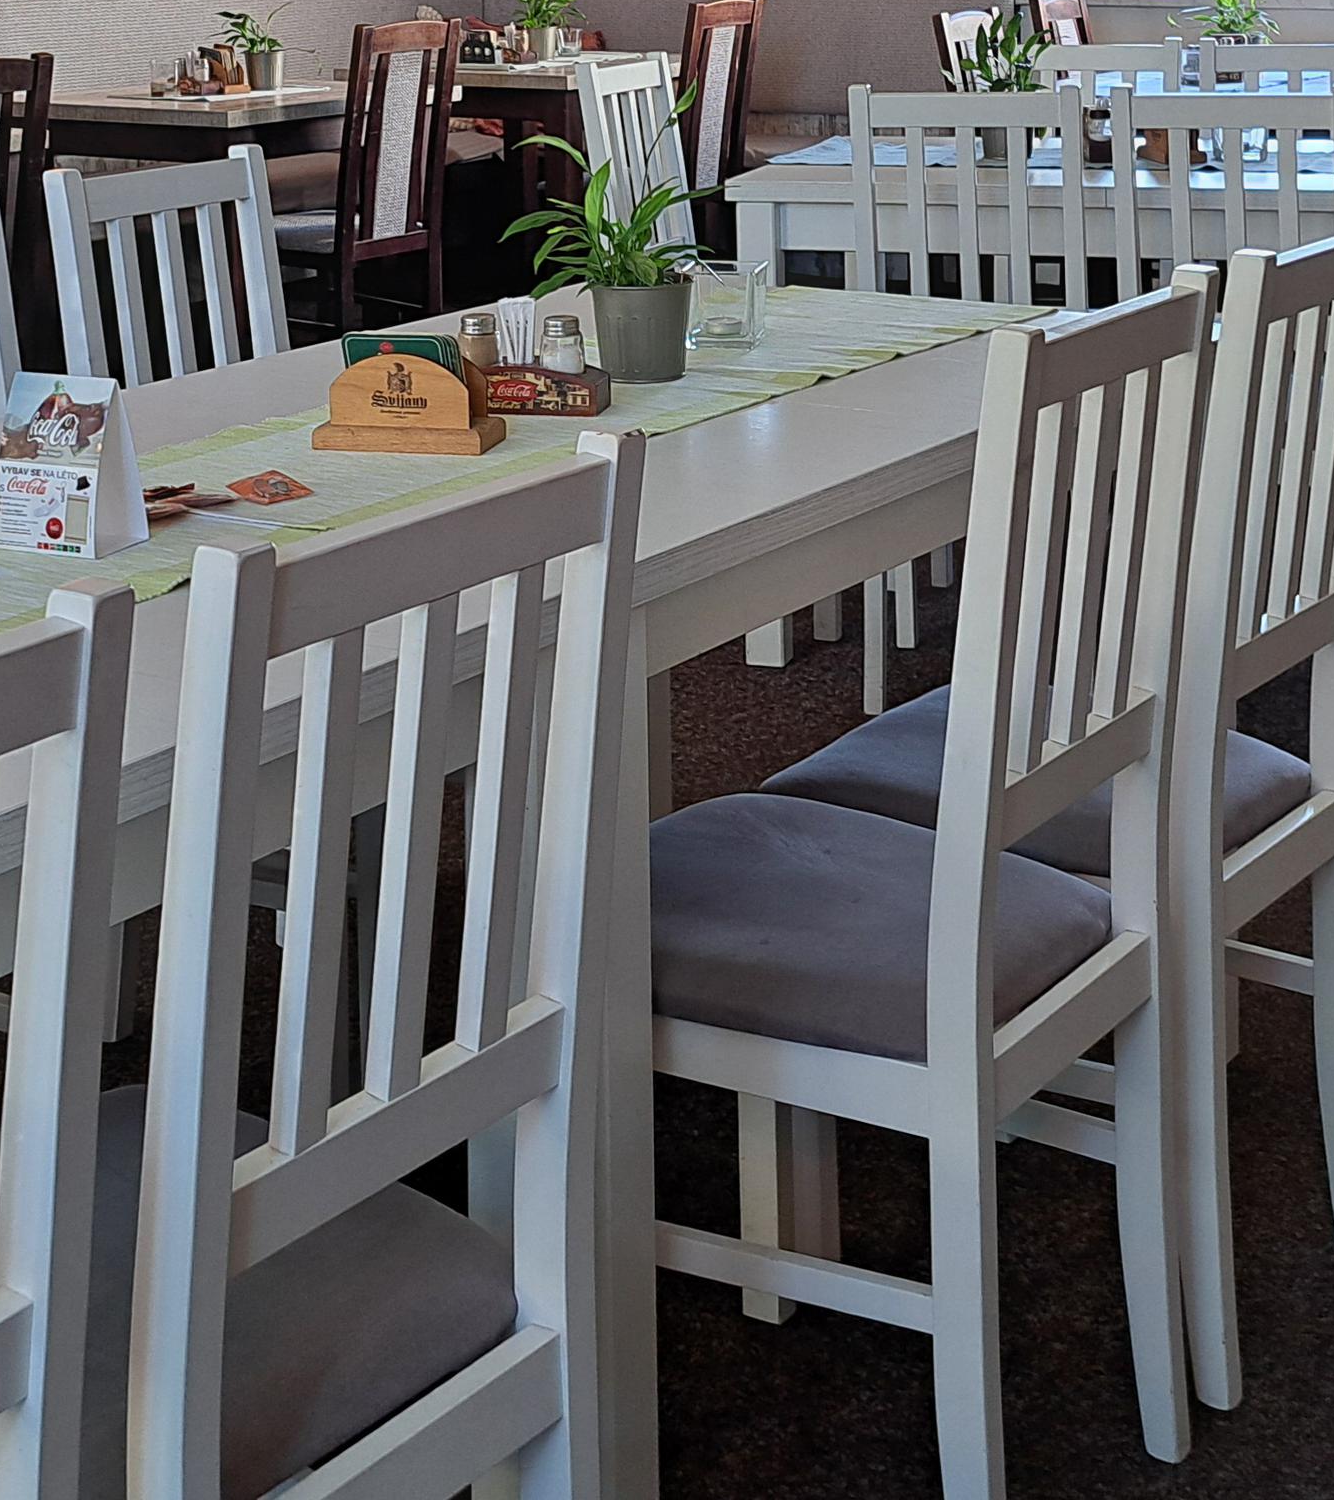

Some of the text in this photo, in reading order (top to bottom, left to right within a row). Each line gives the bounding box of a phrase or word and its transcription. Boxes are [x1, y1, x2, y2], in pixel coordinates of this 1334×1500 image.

[371, 390, 427, 409] Svijany
[1, 466, 78, 480] VYBAV SE NA LÉTO
